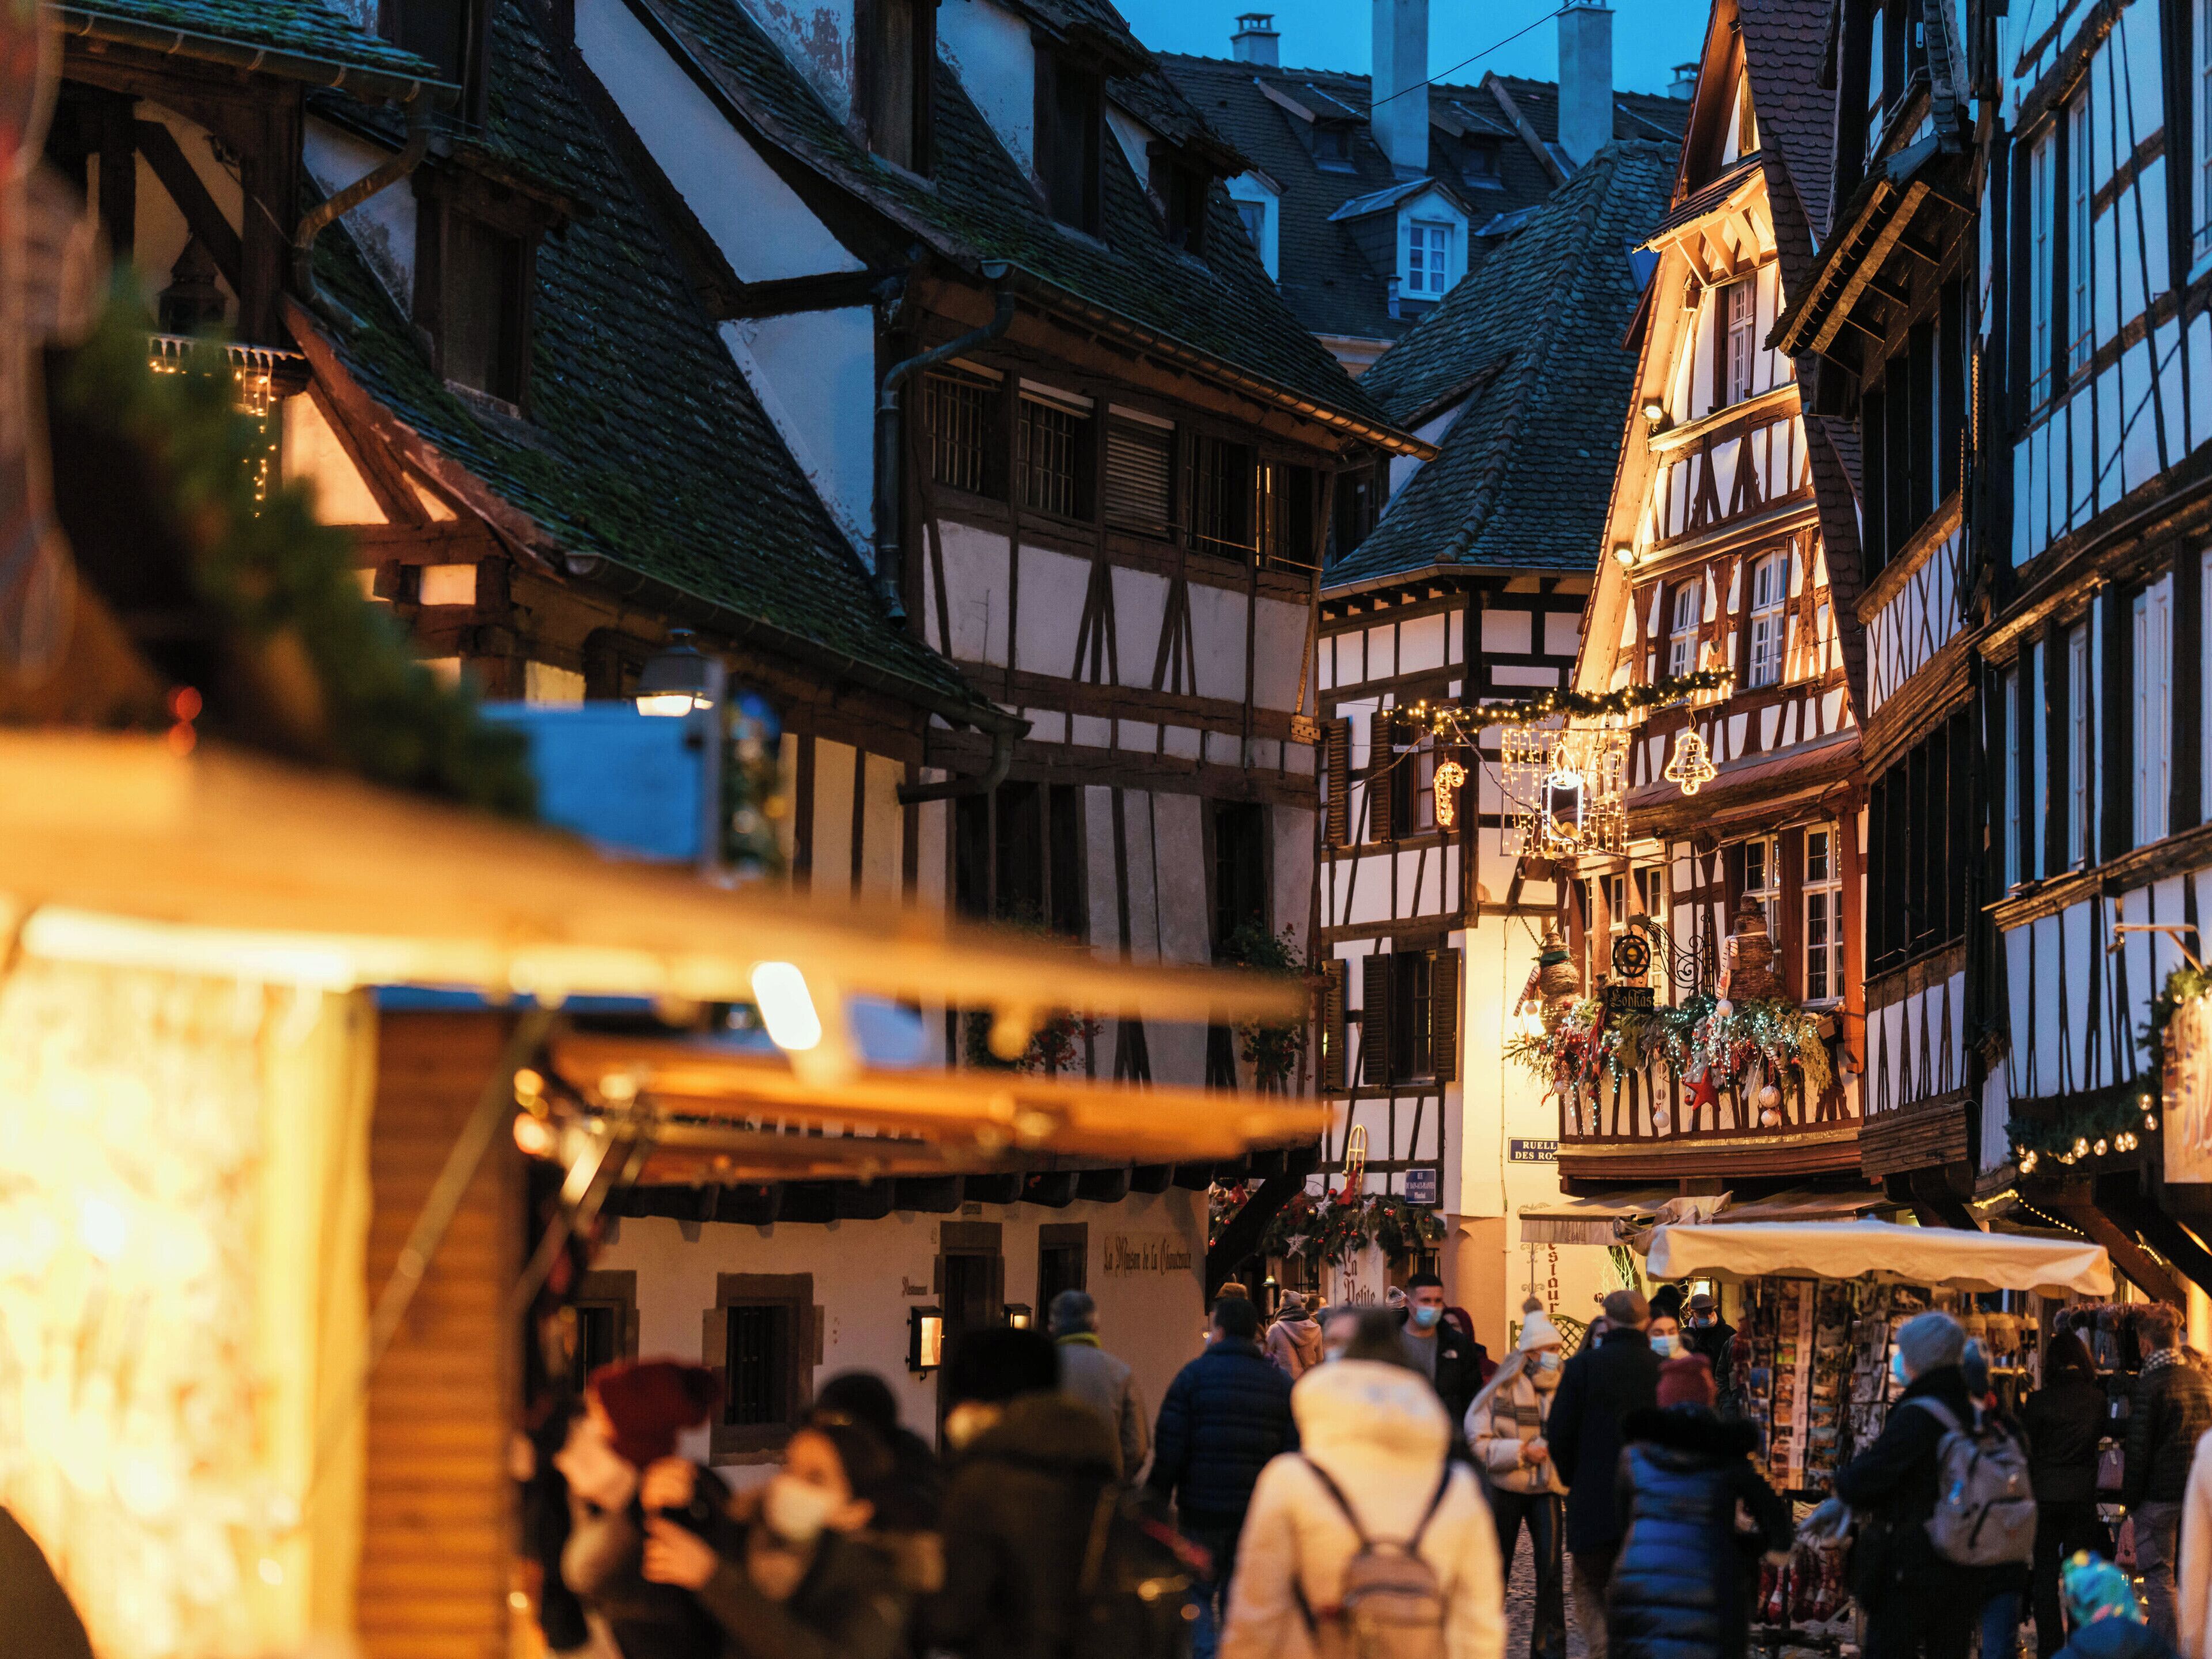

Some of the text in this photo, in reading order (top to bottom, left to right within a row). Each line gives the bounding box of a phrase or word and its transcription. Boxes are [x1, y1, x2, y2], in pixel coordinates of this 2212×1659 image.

[1522, 1141, 1558, 1150] RUELL
[1103, 1236, 1113, 1274] La
[1152, 1244, 1157, 1270] la
[1343, 1245, 1357, 1277] La
[1343, 1278, 1376, 1307] Petite
[1548, 1243, 1560, 1313] estaur
